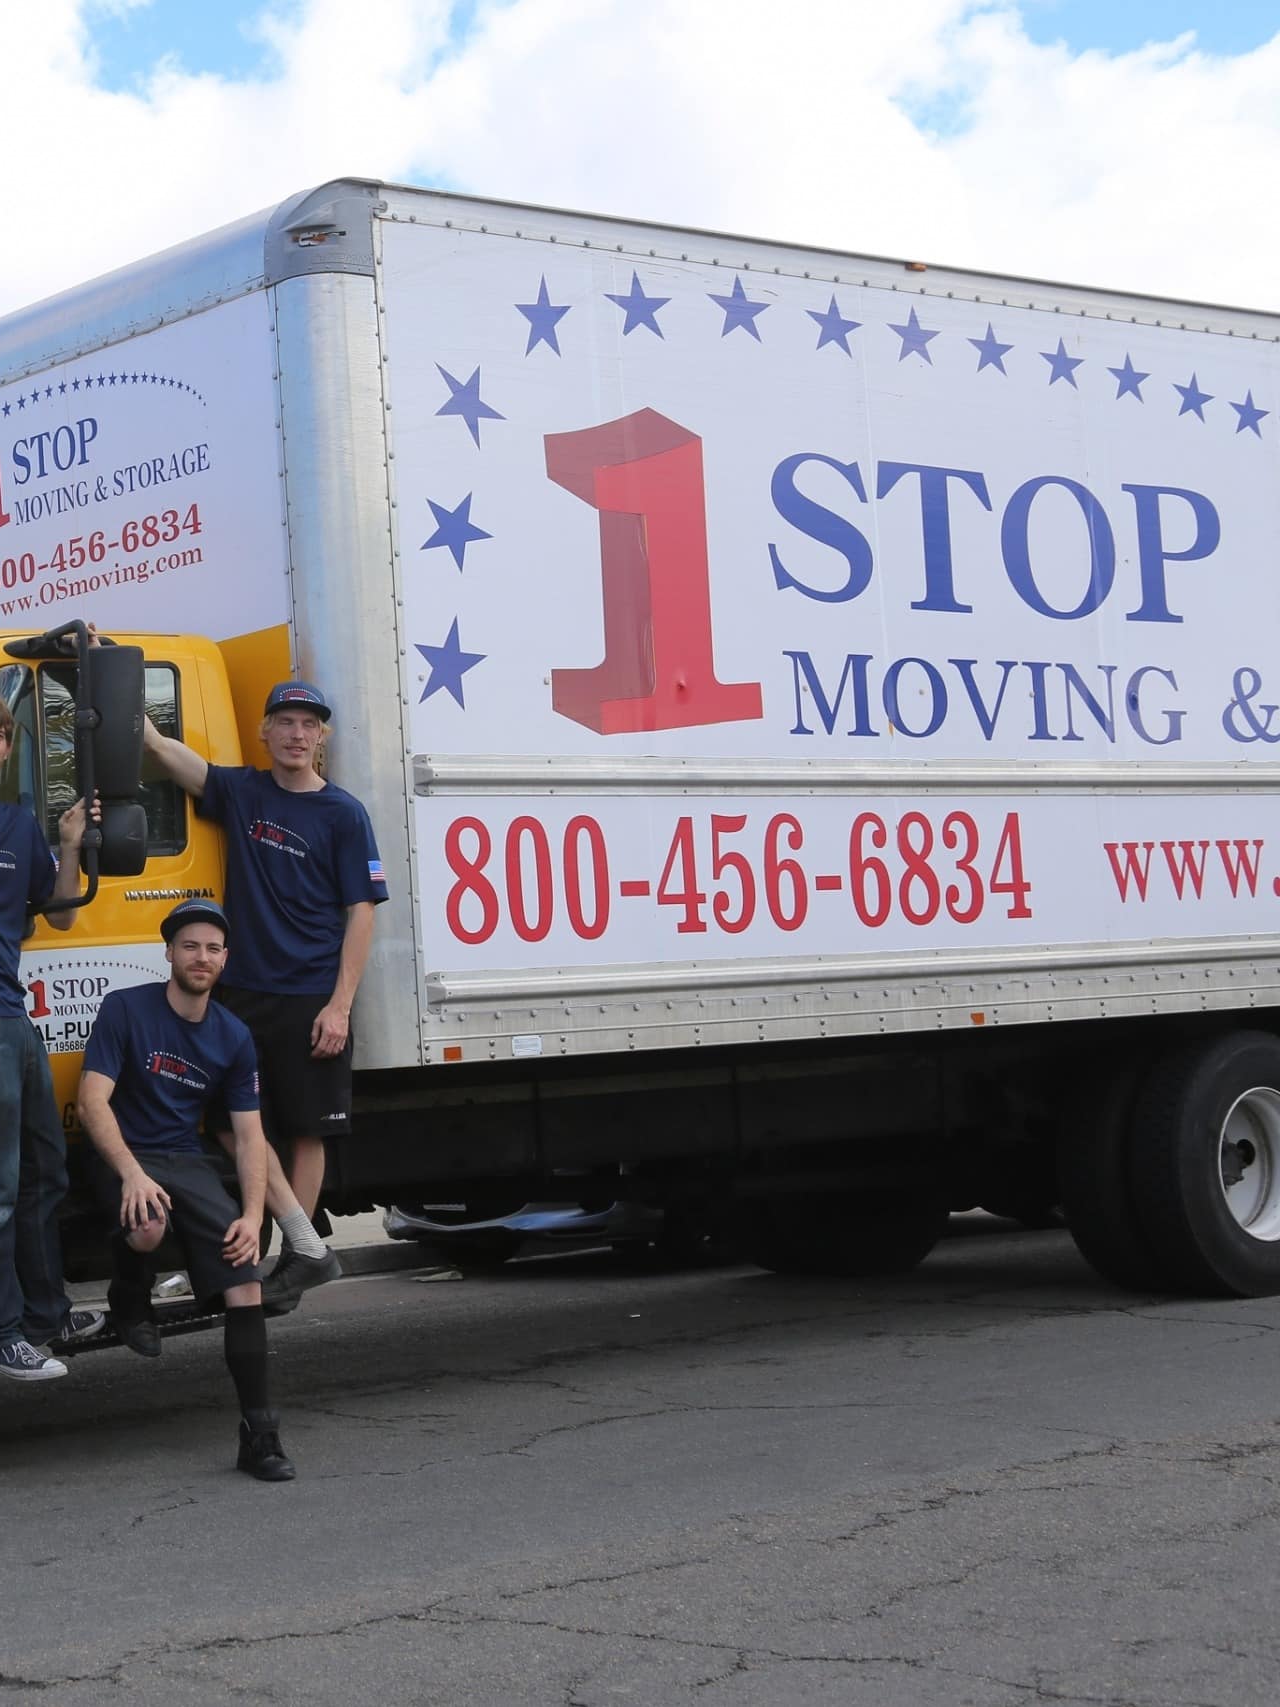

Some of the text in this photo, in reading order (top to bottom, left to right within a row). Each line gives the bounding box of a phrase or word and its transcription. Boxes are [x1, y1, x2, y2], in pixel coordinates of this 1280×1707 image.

[12, 417, 98, 485] STOP
[14, 443, 210, 526] MOVING & STORAGE
[544, 407, 1221, 735] 1 STOP
[782, 651, 1280, 744] MOVING &
[125, 888, 215, 901] INTERNATIONAL
[445, 811, 1033, 944] 800-456-6834
[28, 977, 109, 1018] 1 STOP
